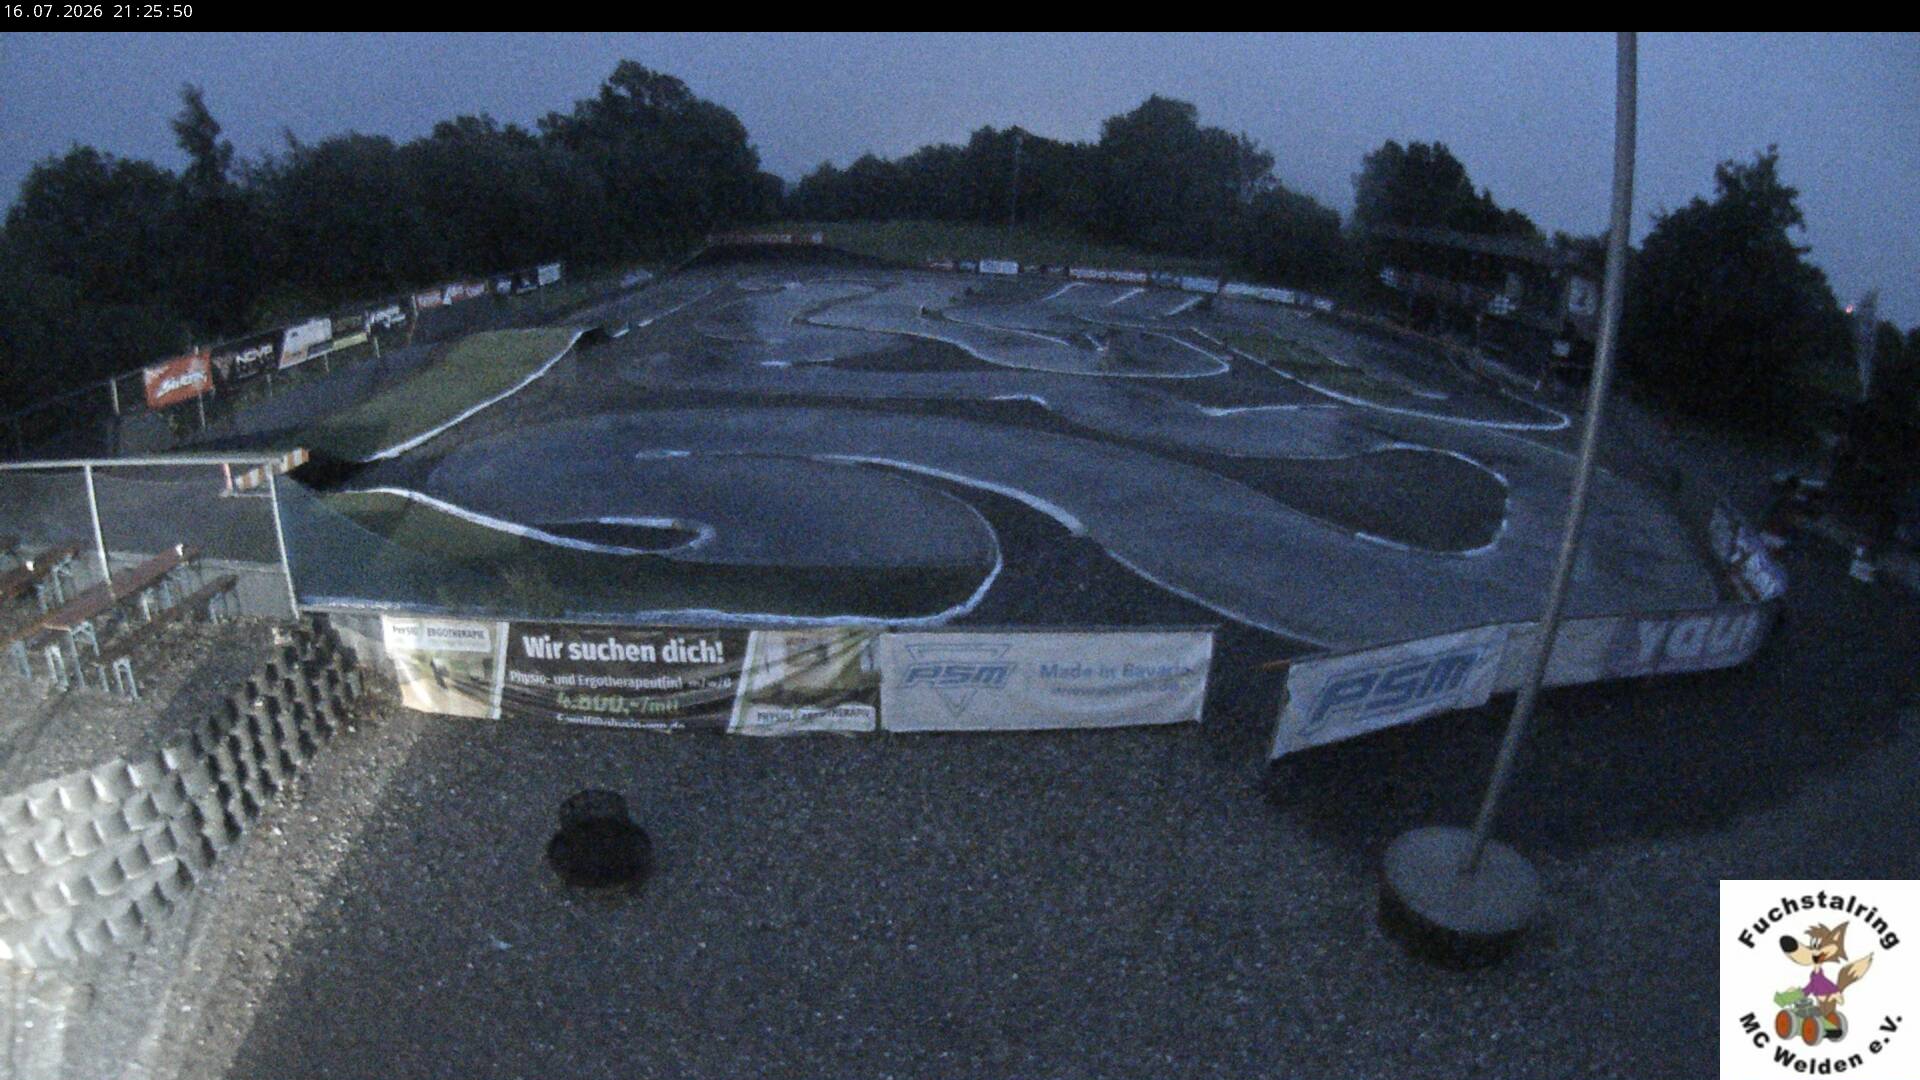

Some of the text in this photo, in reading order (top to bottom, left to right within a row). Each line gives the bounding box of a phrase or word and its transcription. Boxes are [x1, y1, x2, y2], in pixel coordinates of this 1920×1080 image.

[522, 634, 725, 664] Wir suchen dich!
[509, 671, 551, 686] Physio-
[553, 673, 575, 686] und
[905, 665, 1008, 688] PSM
[1040, 663, 1092, 678] Made
[1311, 652, 1480, 724] PSM
